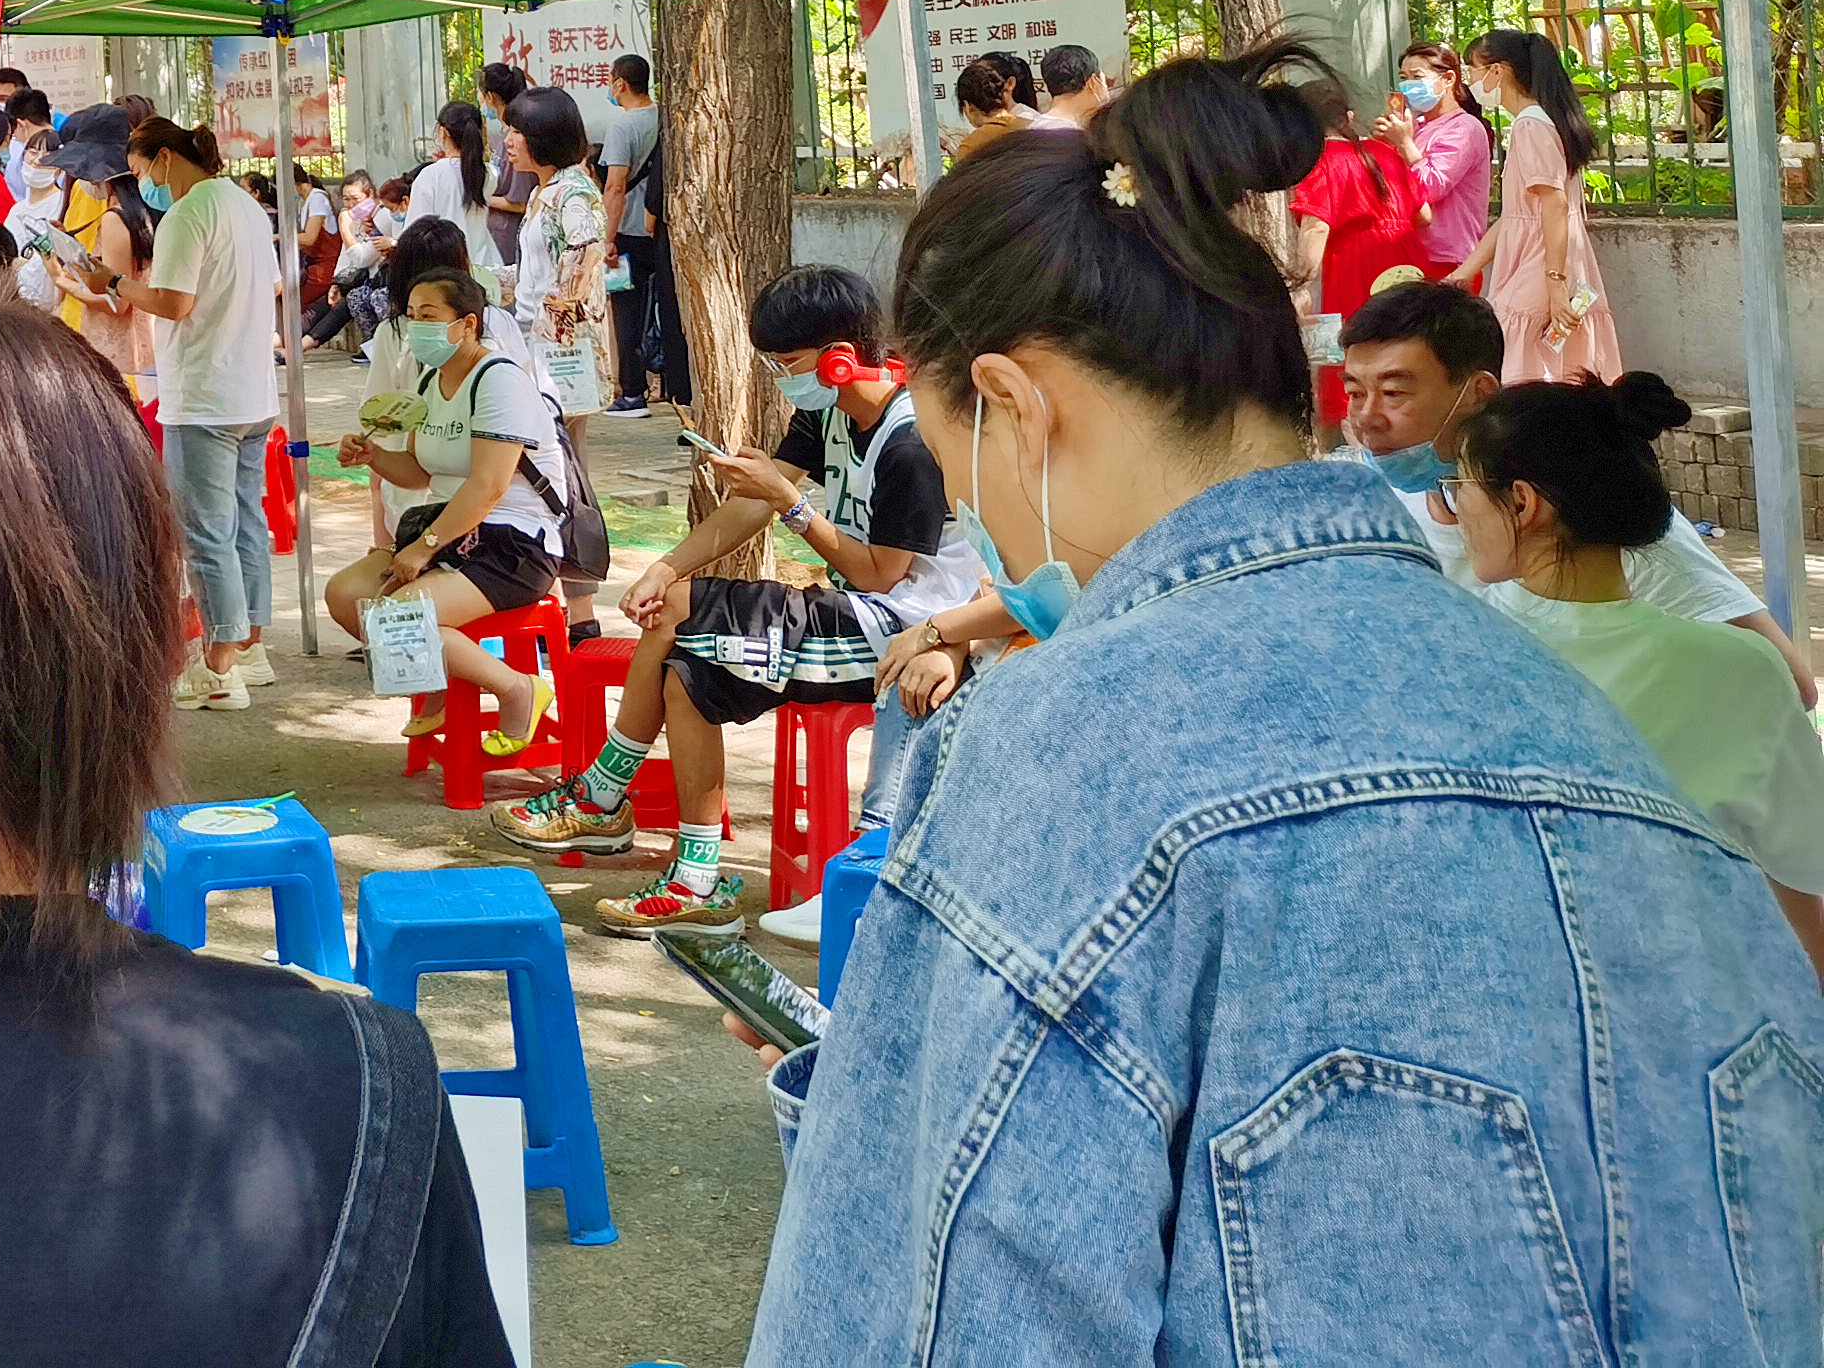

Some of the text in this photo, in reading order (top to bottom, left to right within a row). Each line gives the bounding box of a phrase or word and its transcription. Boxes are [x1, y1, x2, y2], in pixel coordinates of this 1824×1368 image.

[548, 23, 625, 54] 敬天下老人
[950, 27, 978, 45] 民主
[987, 23, 1016, 41] 文明
[1025, 20, 1057, 38] 和谐
[768, 627, 784, 680] adidas
